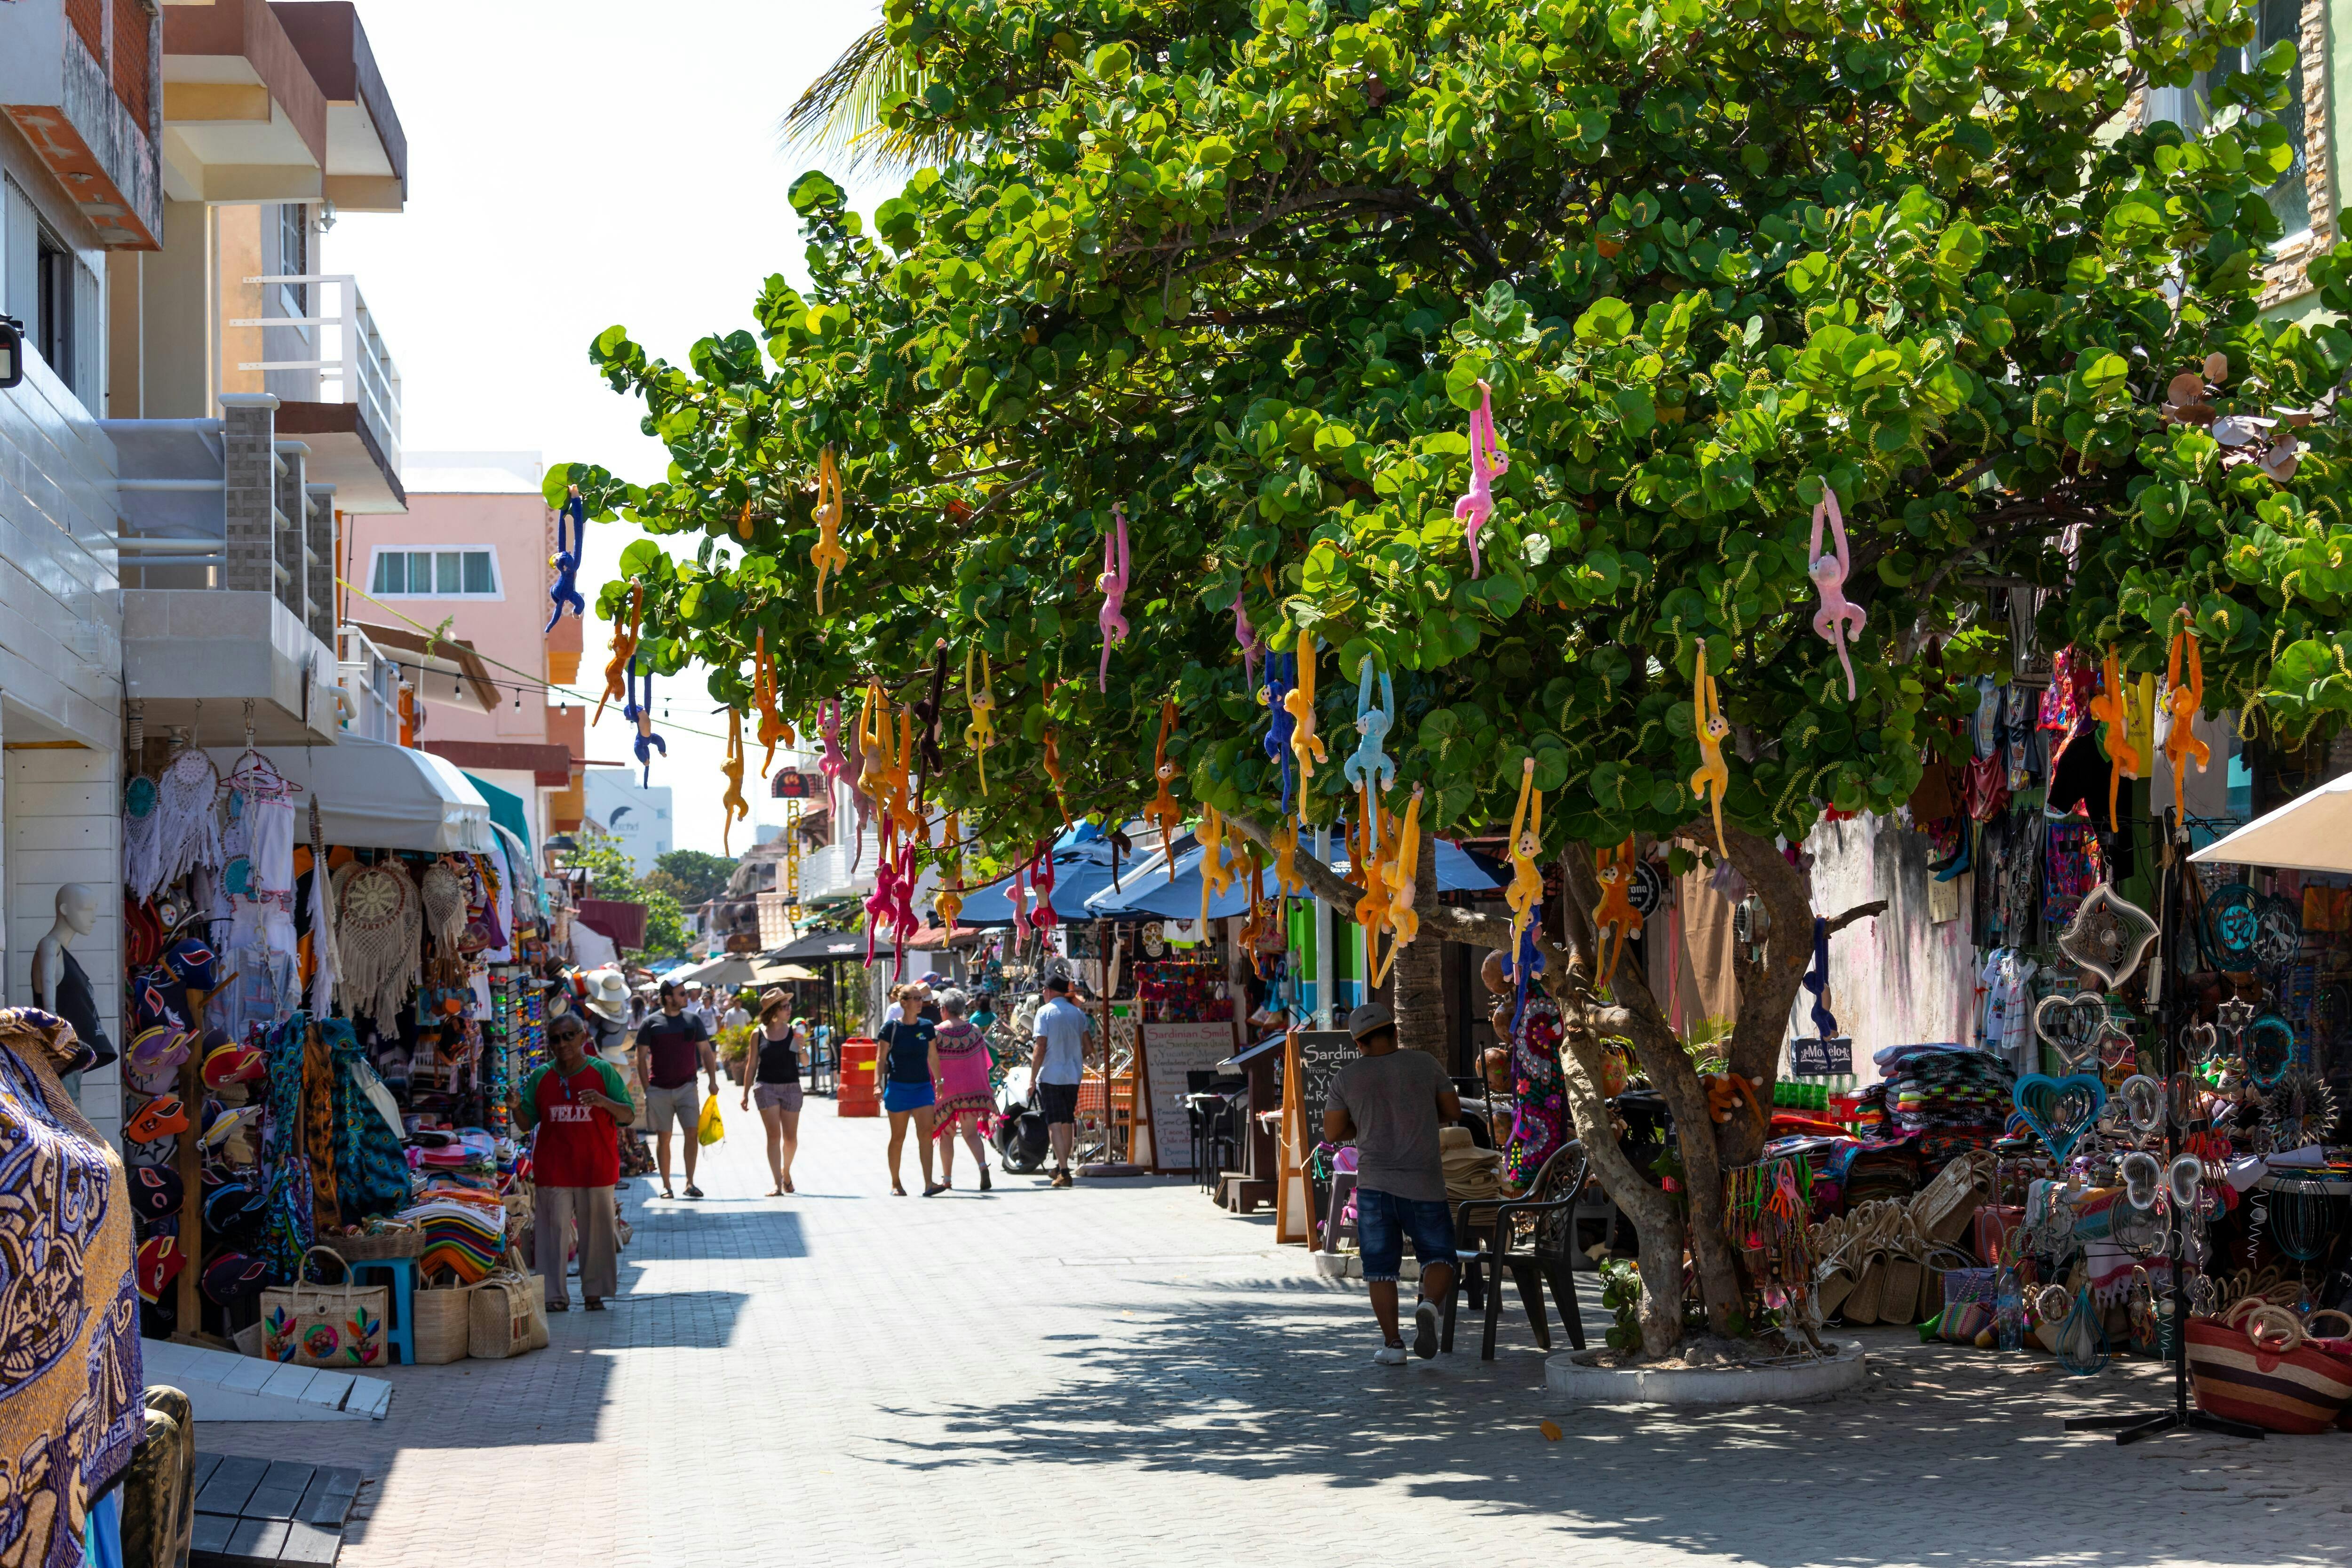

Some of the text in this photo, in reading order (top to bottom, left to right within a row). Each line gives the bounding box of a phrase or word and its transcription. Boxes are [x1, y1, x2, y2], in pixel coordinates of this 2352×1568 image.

[1146, 1026, 1230, 1041] Sardinian Smile
[1165, 1039, 1208, 1050] Sardegna
[1304, 1043, 1363, 1063] Sardini
[1807, 1045, 1842, 1058] Moelo
[1307, 1065, 1327, 1074] from
[1315, 1090, 1329, 1102] Re
[595, 1104, 640, 1122] FELIX
[1311, 1123, 1325, 1134] Fe
